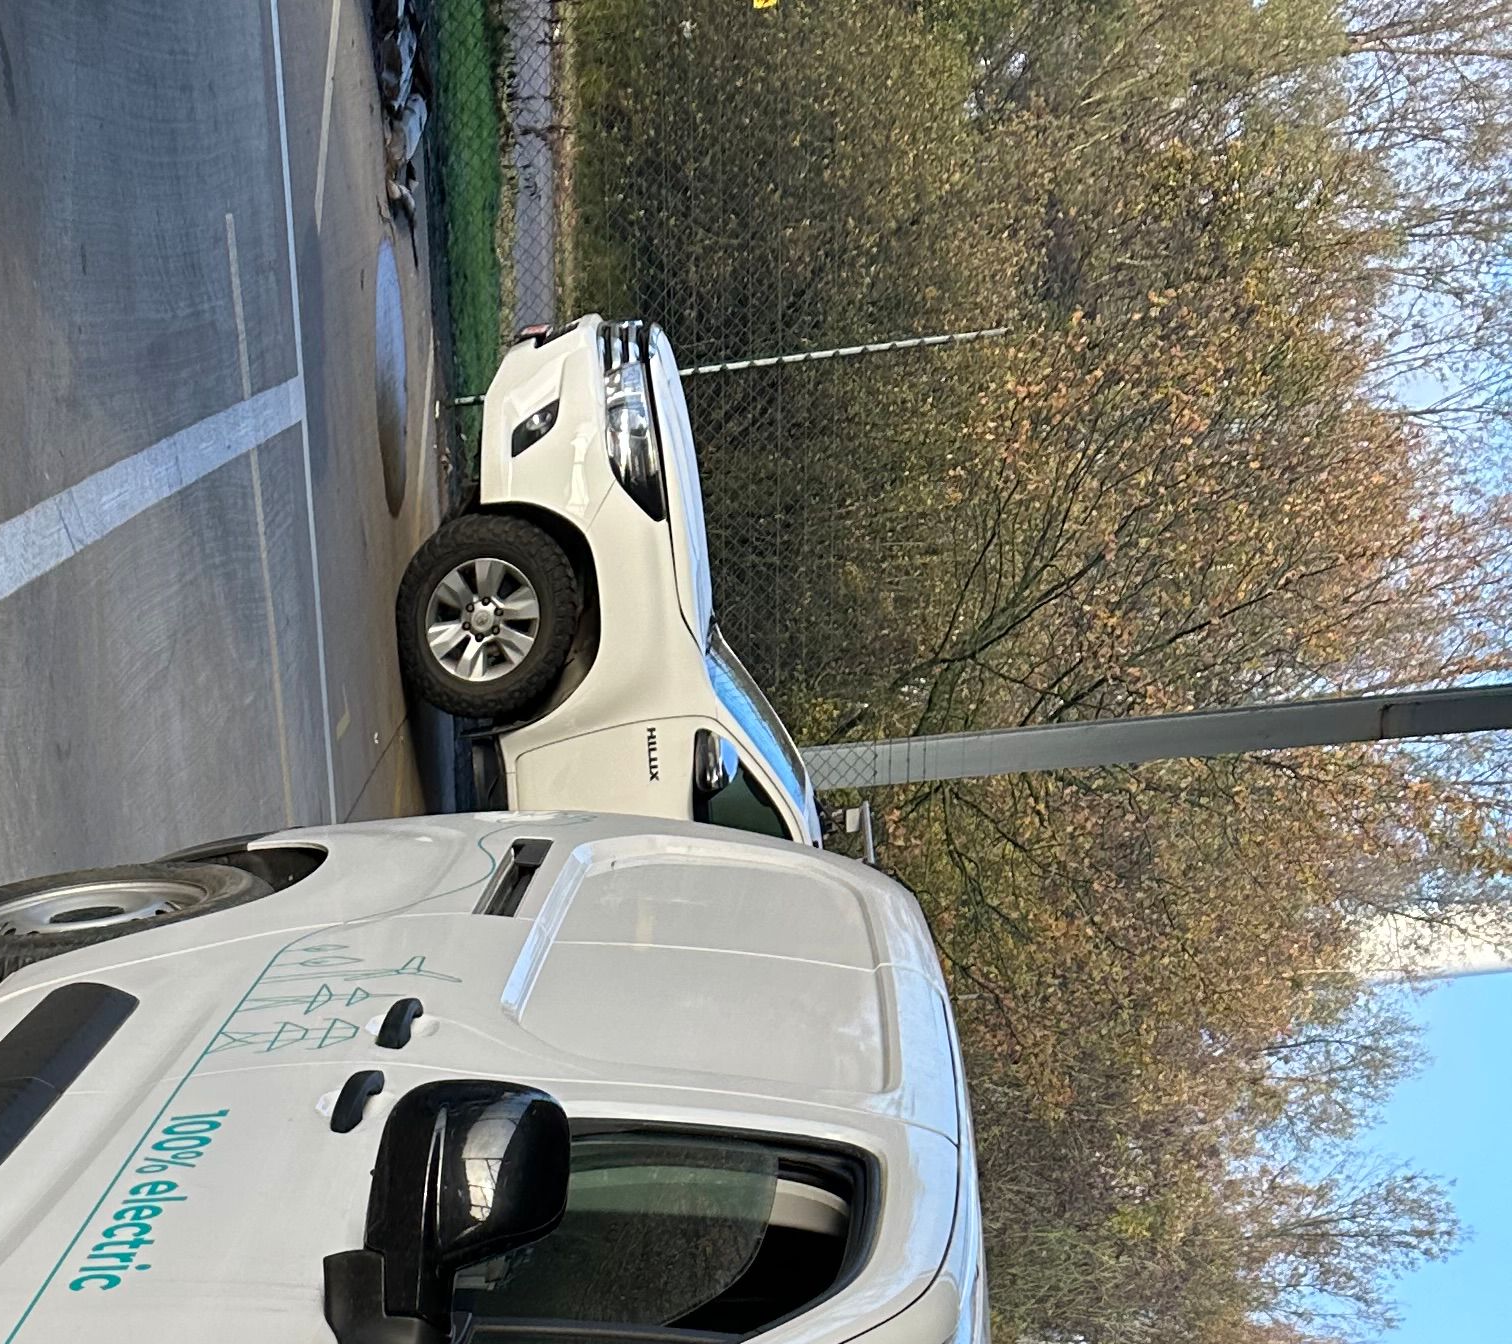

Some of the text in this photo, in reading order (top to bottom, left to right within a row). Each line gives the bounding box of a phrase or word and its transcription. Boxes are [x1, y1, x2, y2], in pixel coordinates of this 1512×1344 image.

[647, 728, 660, 781] HILUX
[69, 1109, 229, 1291] 100% electric
